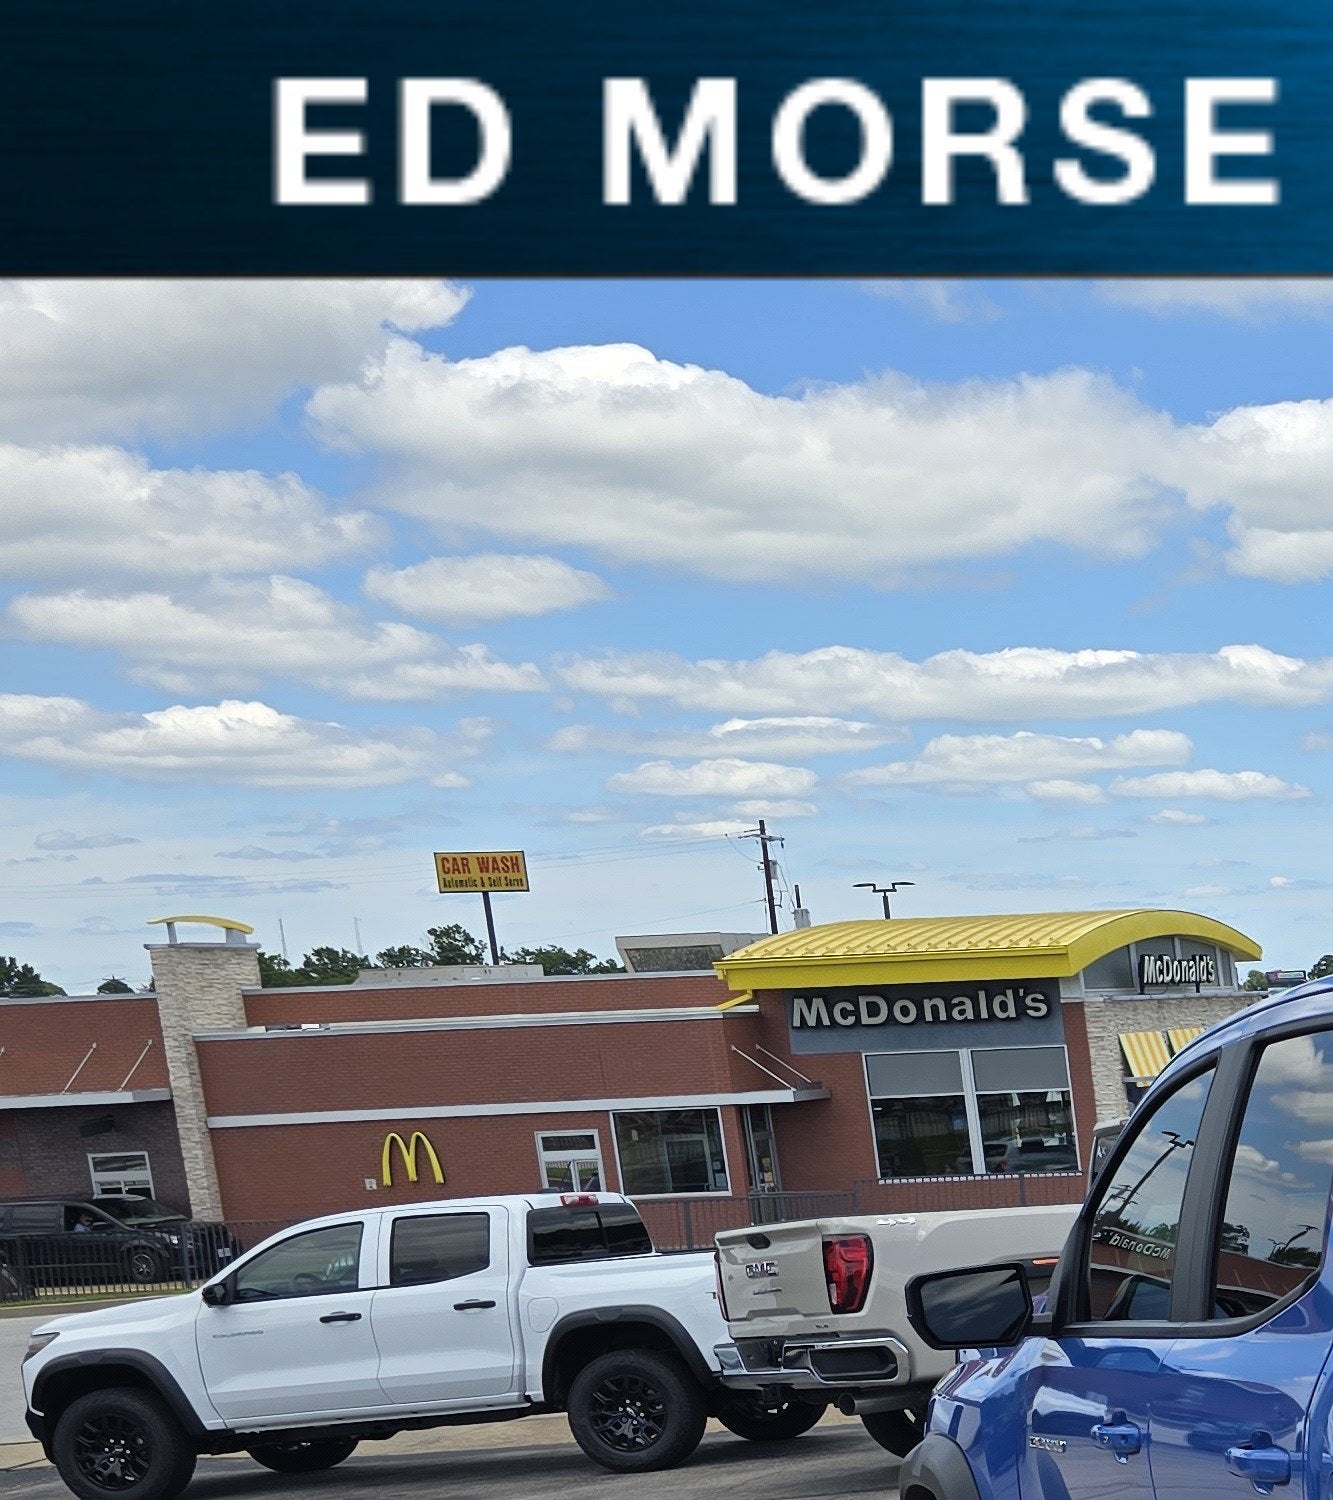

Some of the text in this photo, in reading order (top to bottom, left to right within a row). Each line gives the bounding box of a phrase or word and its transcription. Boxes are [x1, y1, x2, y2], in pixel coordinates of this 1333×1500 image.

[440, 855, 521, 875] CAR WASH
[1143, 955, 1215, 984] McDonald's
[792, 988, 1049, 1028] McDonald's
